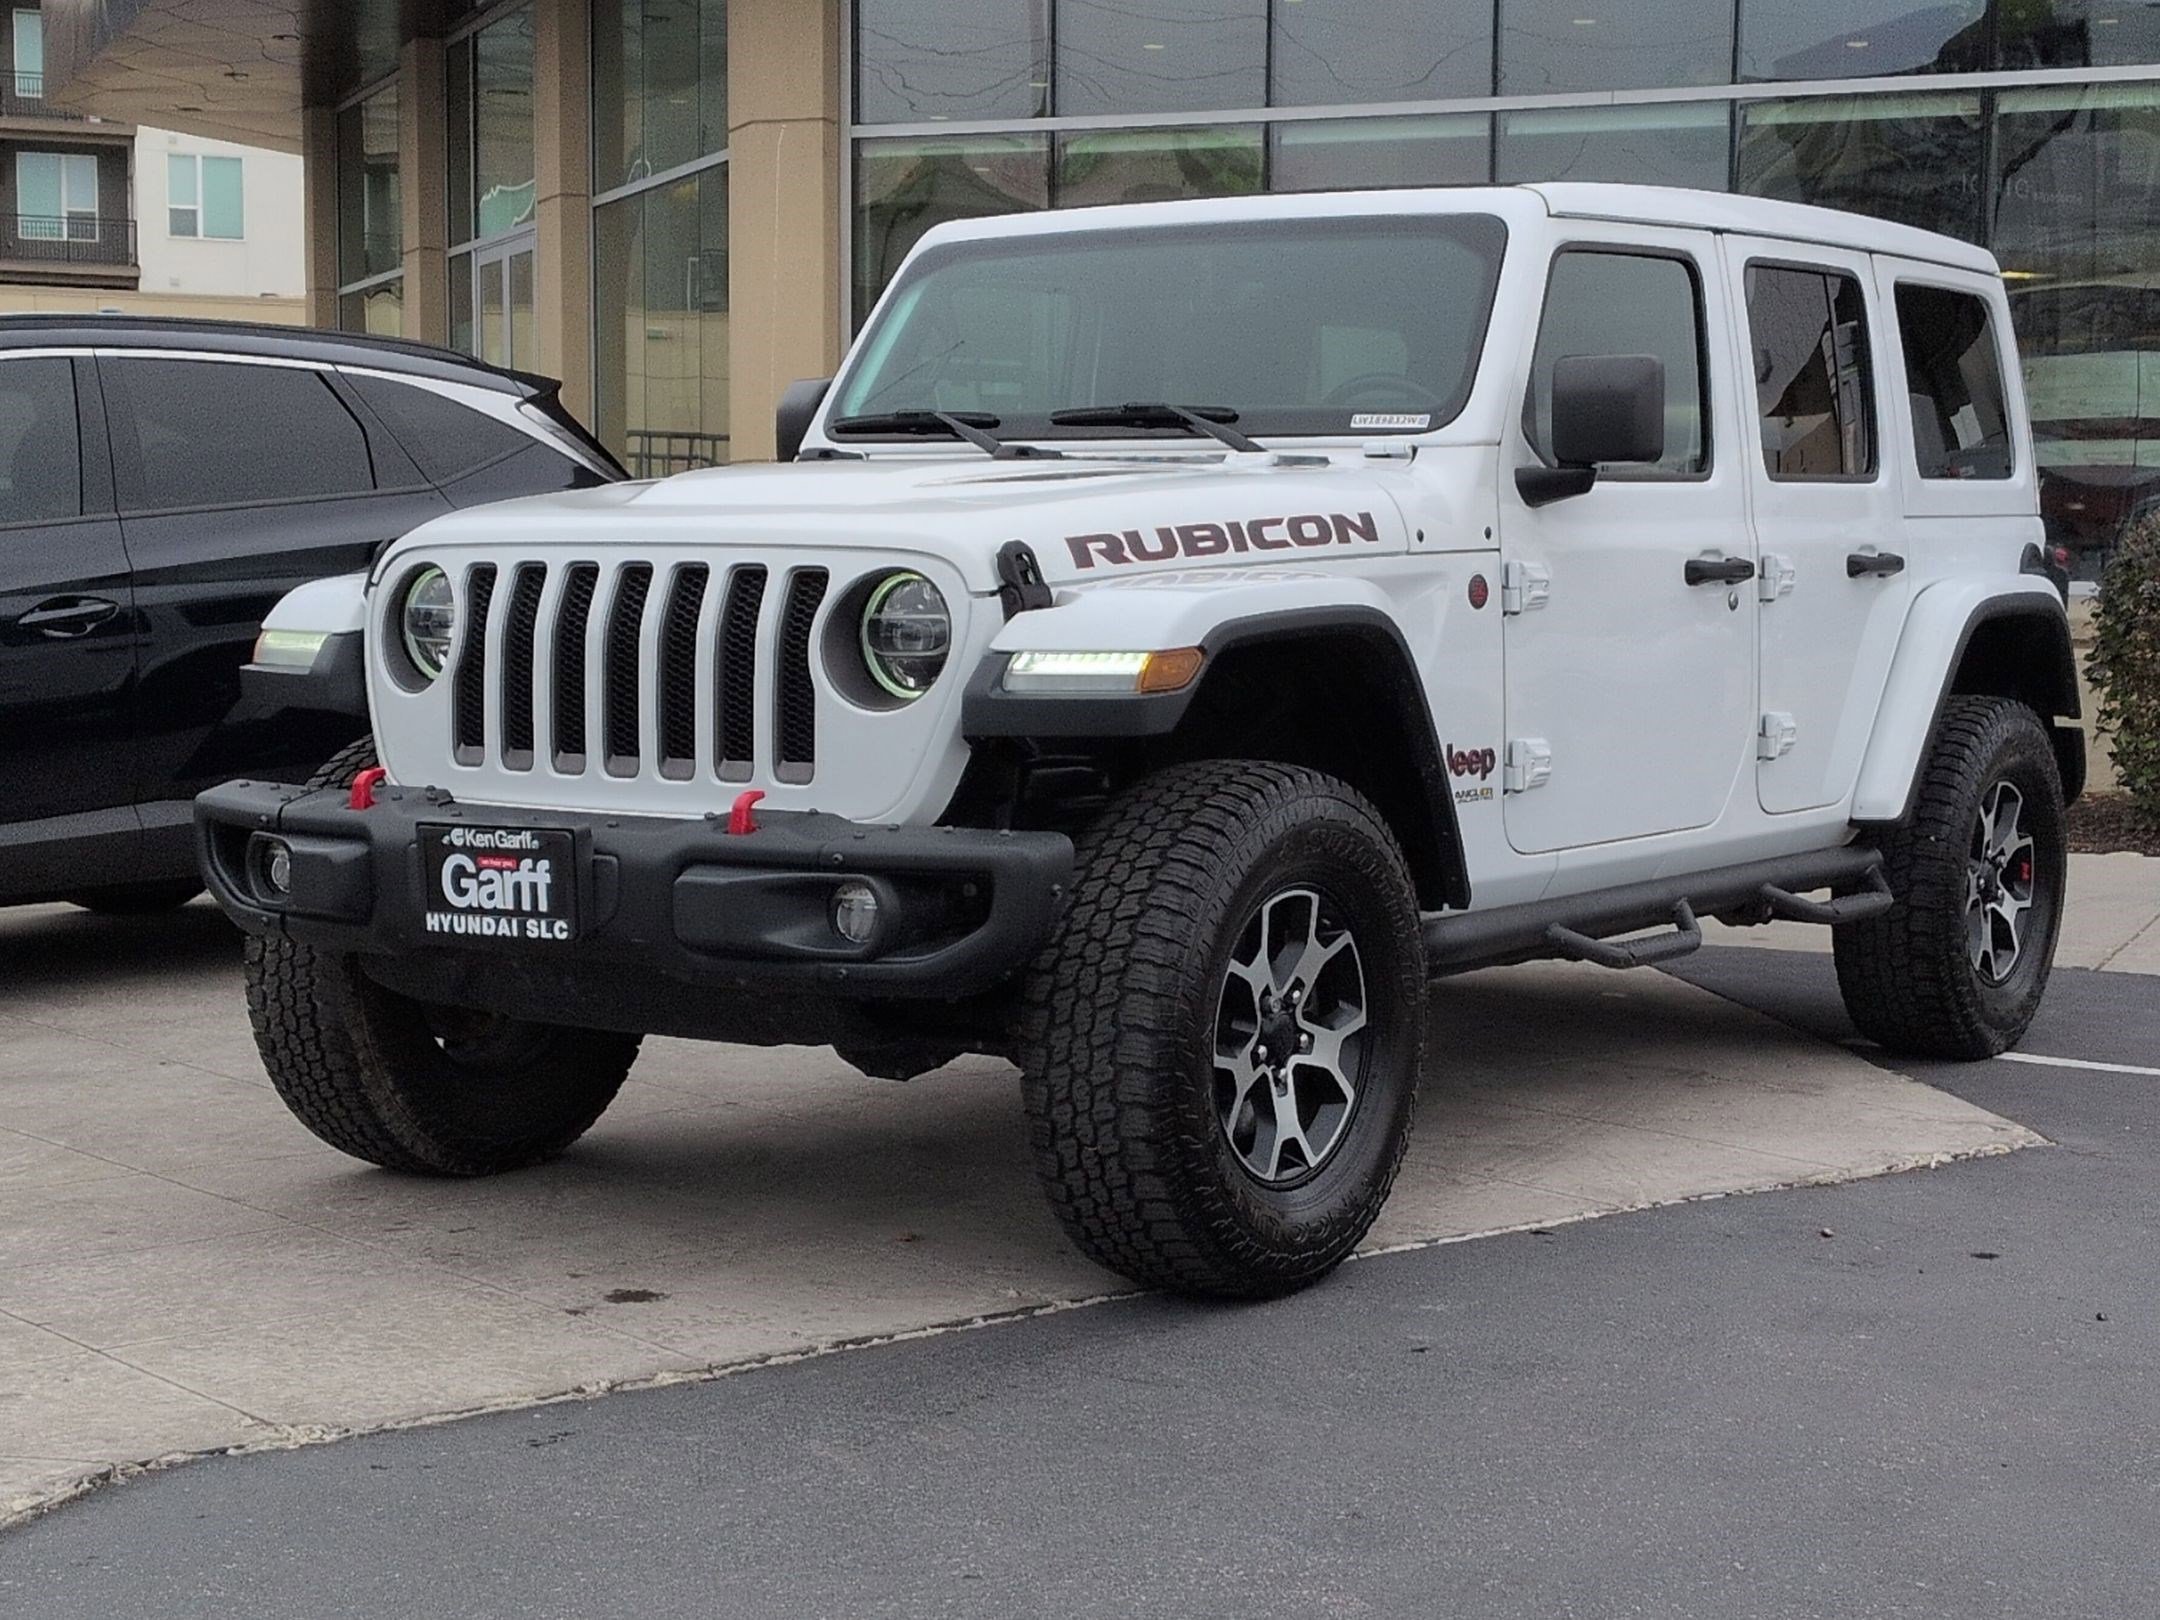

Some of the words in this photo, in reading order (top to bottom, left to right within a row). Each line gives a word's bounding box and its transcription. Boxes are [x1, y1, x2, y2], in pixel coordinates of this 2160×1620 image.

[1065, 512, 1379, 569] RUBICON
[441, 853, 551, 912] Garff
[426, 912, 518, 937] HYUNDAI
[526, 919, 569, 940] SLC
